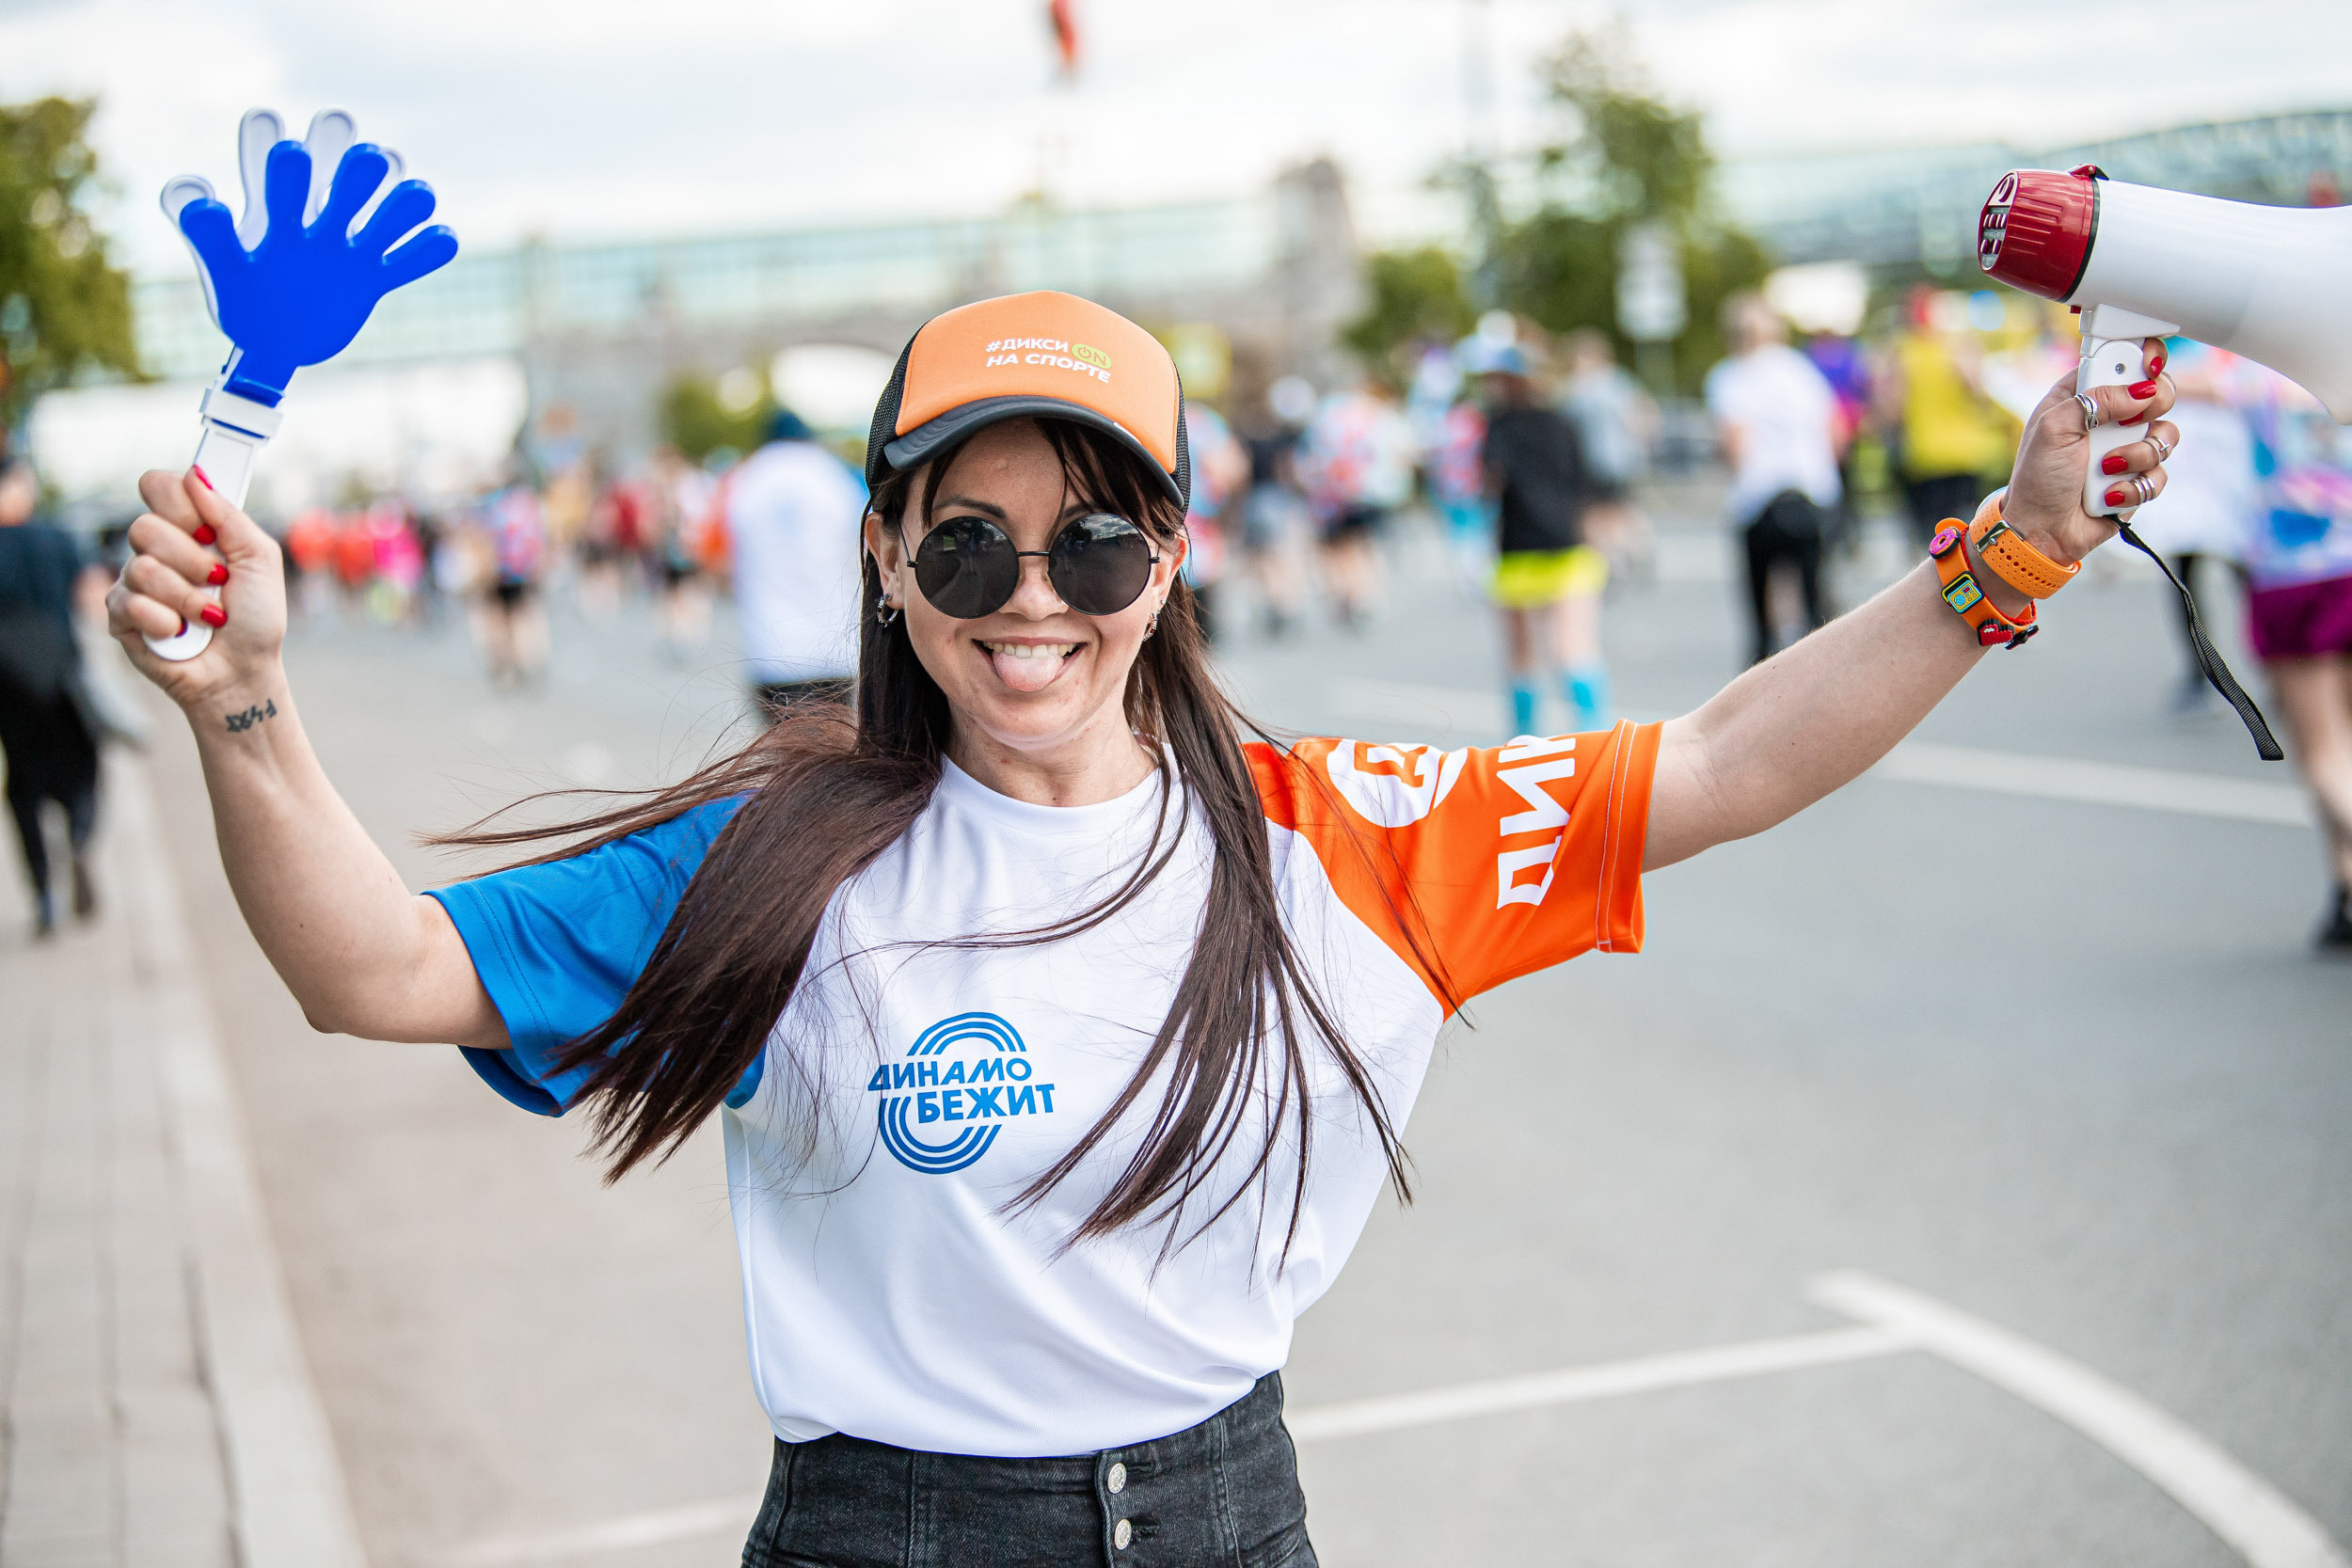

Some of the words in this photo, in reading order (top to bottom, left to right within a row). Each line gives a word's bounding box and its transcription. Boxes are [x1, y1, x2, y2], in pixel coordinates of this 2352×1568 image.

[987, 338, 1068, 353] #ДИКСИ
[986, 354, 1018, 368] НА
[1025, 354, 1111, 384] СПОРТЕ
[867, 1058, 1032, 1091] ДИНАМО
[917, 1084, 1055, 1124] БЕЖИТ
